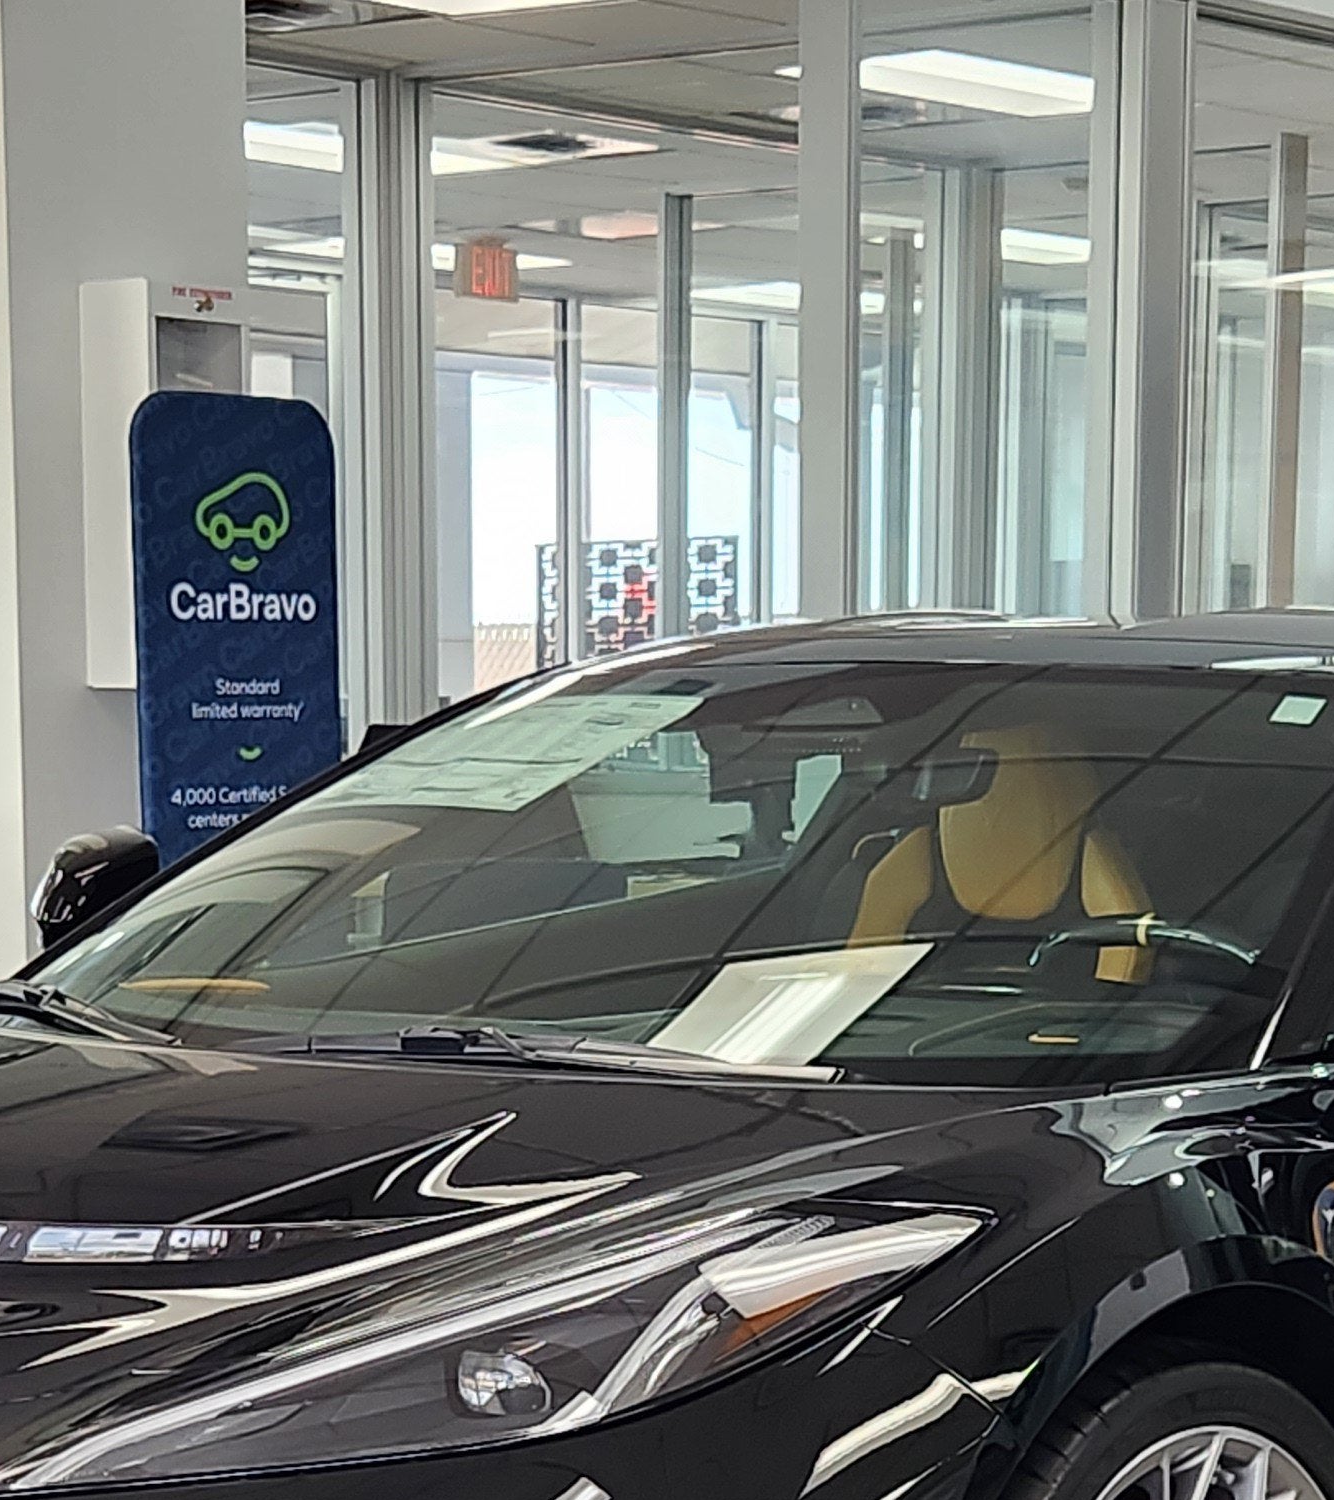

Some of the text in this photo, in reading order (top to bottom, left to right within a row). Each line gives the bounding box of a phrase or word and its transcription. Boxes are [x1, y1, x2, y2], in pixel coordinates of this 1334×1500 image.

[170, 581, 317, 621] CarBravo
[215, 678, 281, 695] Standard
[191, 702, 238, 720] limited
[171, 787, 216, 807] 4,000
[218, 785, 277, 804] Certified
